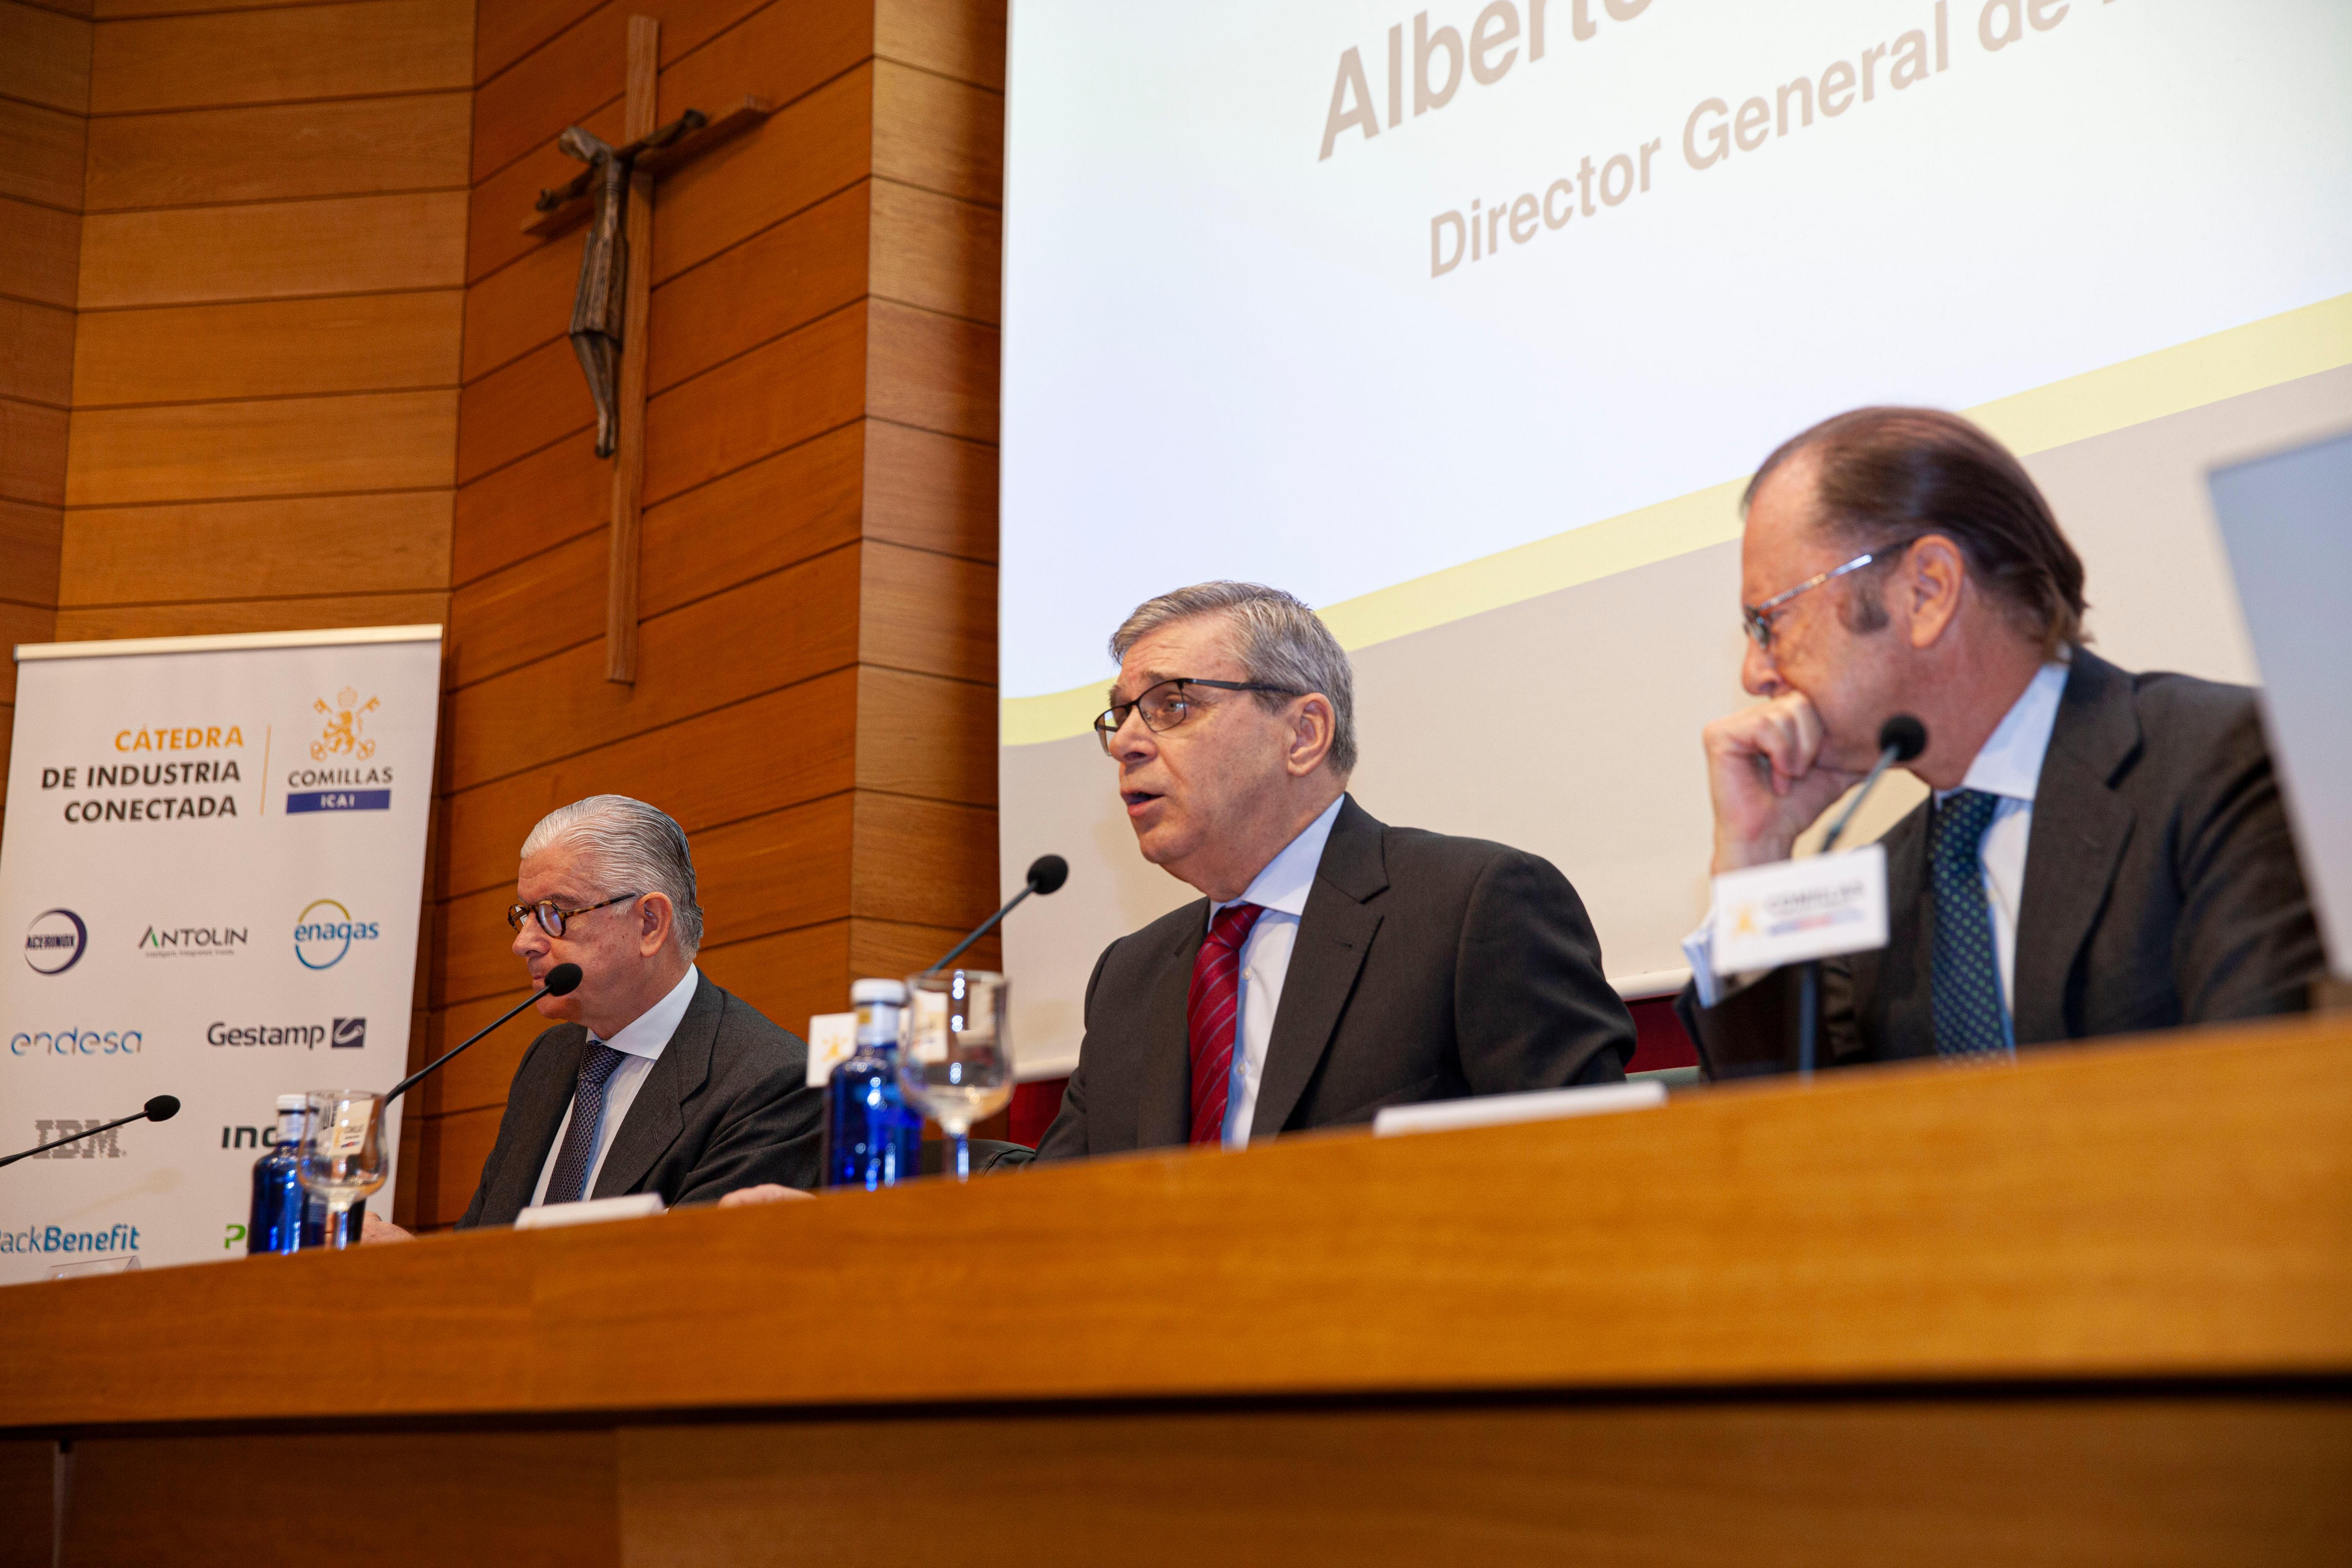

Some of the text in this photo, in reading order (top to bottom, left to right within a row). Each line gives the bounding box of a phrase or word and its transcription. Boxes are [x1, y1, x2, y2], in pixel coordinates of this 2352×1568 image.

[1430, 137, 1661, 278] Director
[1682, 0, 1949, 170] General
[114, 724, 244, 752] CÁTEDRA
[42, 761, 240, 789] DE INDUSTRIA
[288, 767, 393, 787] COMILLAS
[64, 795, 237, 823] CONECTADA
[320, 794, 355, 808] ICAI
[138, 925, 248, 948] ANTOLIN
[294, 921, 379, 942] enagas
[11, 1027, 142, 1055] endesa
[207, 1021, 325, 1050] Gestamp
[33, 1119, 124, 1159] IBM
[0, 1224, 139, 1253] ackBenefit
